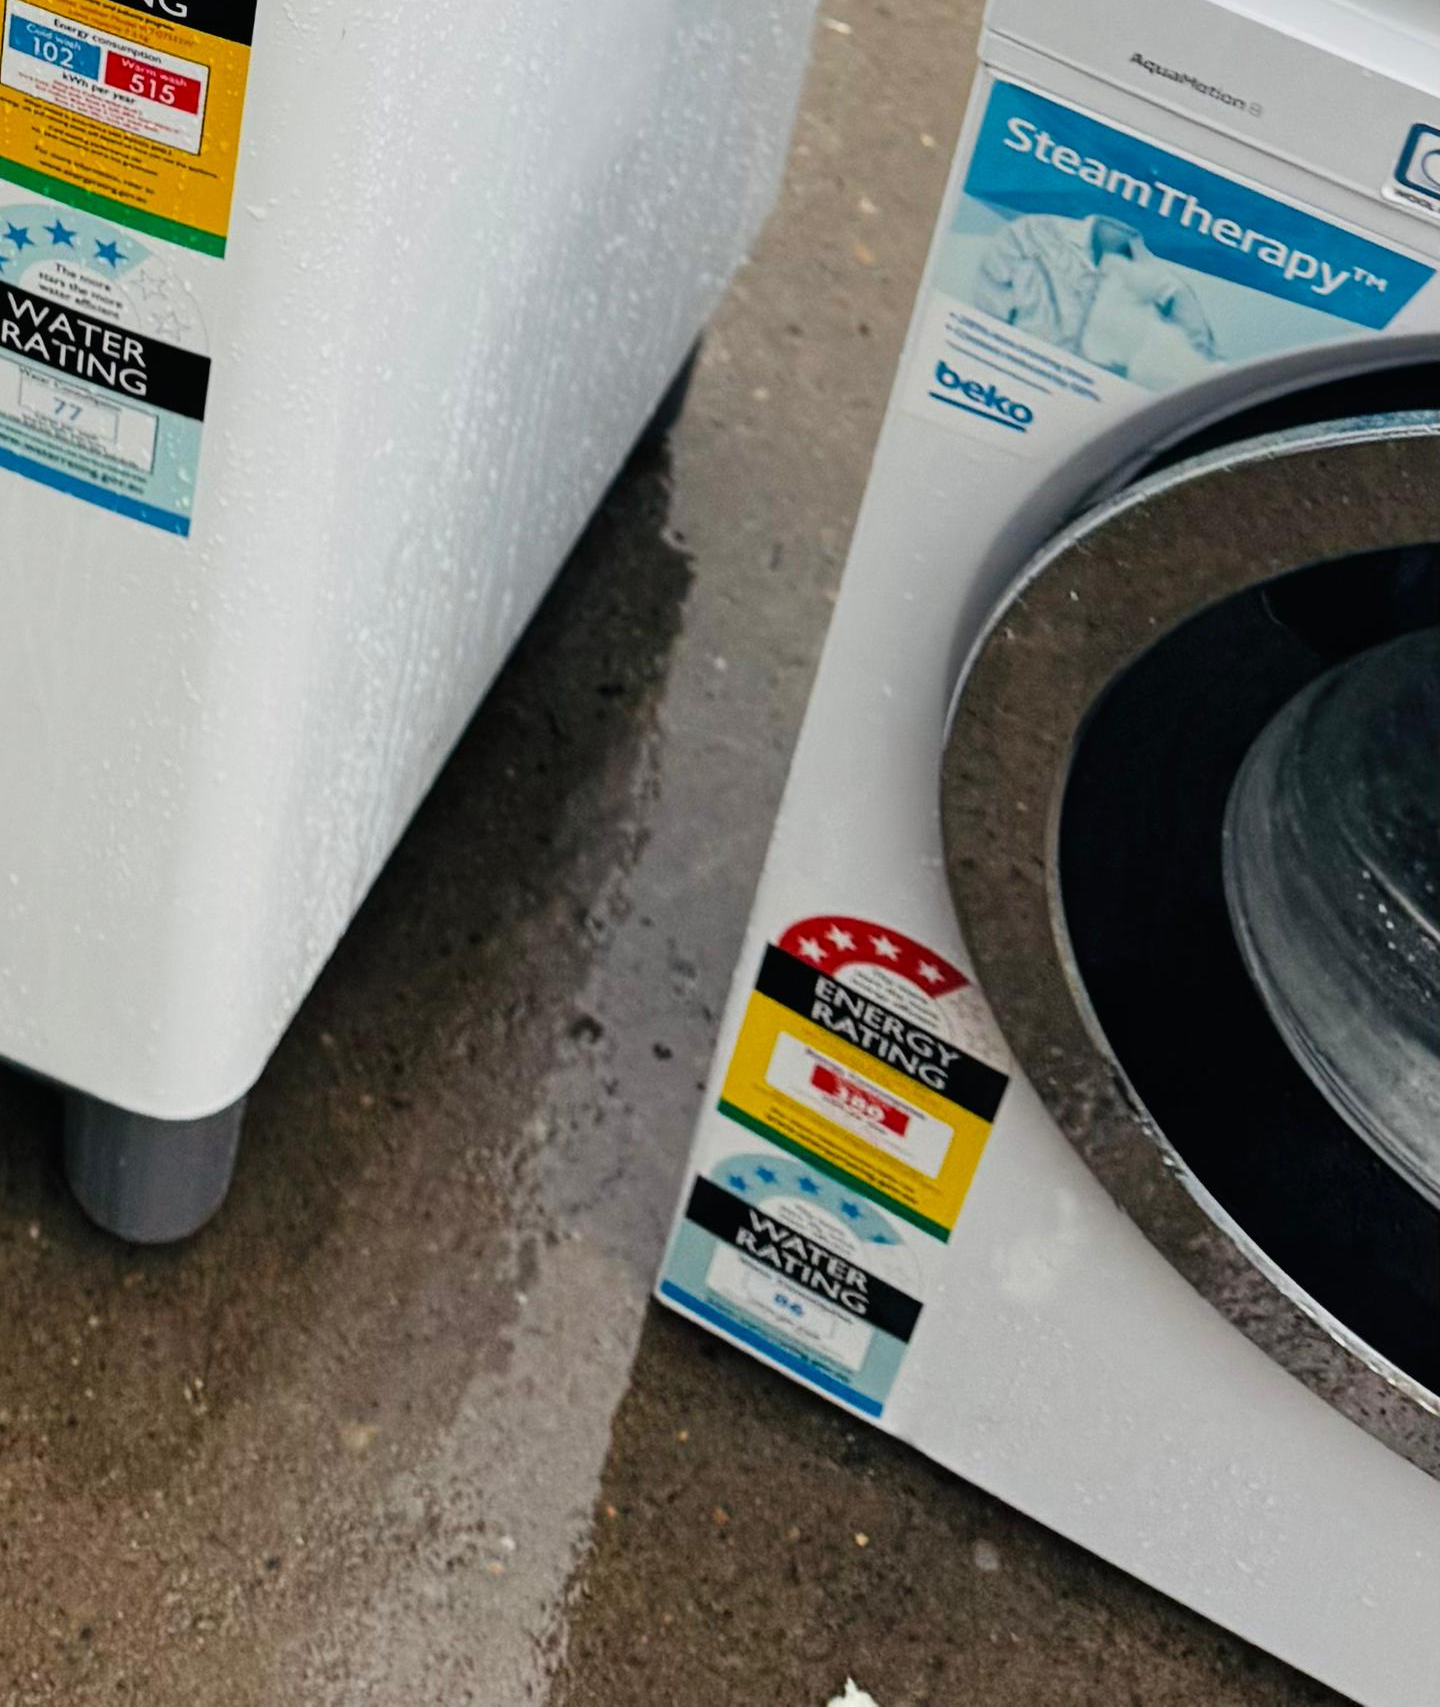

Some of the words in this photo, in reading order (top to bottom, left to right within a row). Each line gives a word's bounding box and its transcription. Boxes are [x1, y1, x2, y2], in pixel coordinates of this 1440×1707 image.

[32, 36, 74, 70] 102
[53, 17, 89, 42] Energy
[91, 34, 162, 65] consumption
[55, 32, 81, 52] wash
[62, 72, 89, 90] kWh
[90, 81, 109, 98] per
[111, 89, 137, 106] year
[121, 57, 159, 80] Warm
[160, 69, 188, 88] wash
[128, 72, 176, 106] 515
[1127, 50, 1249, 112] AquaMotion
[38, 271, 66, 289] stars
[68, 280, 89, 299] the
[91, 290, 123, 309] more
[38, 282, 71, 302] water
[74, 295, 120, 320] efficient
[79, 273, 111, 292] more
[6, 291, 147, 369] WATER
[0, 318, 148, 396] RATING
[934, 359, 1035, 426] beko
[813, 973, 962, 1071] ENERGY
[810, 1000, 947, 1094] RATING
[733, 1224, 871, 1318] RATING
[745, 1207, 871, 1295] WATER
